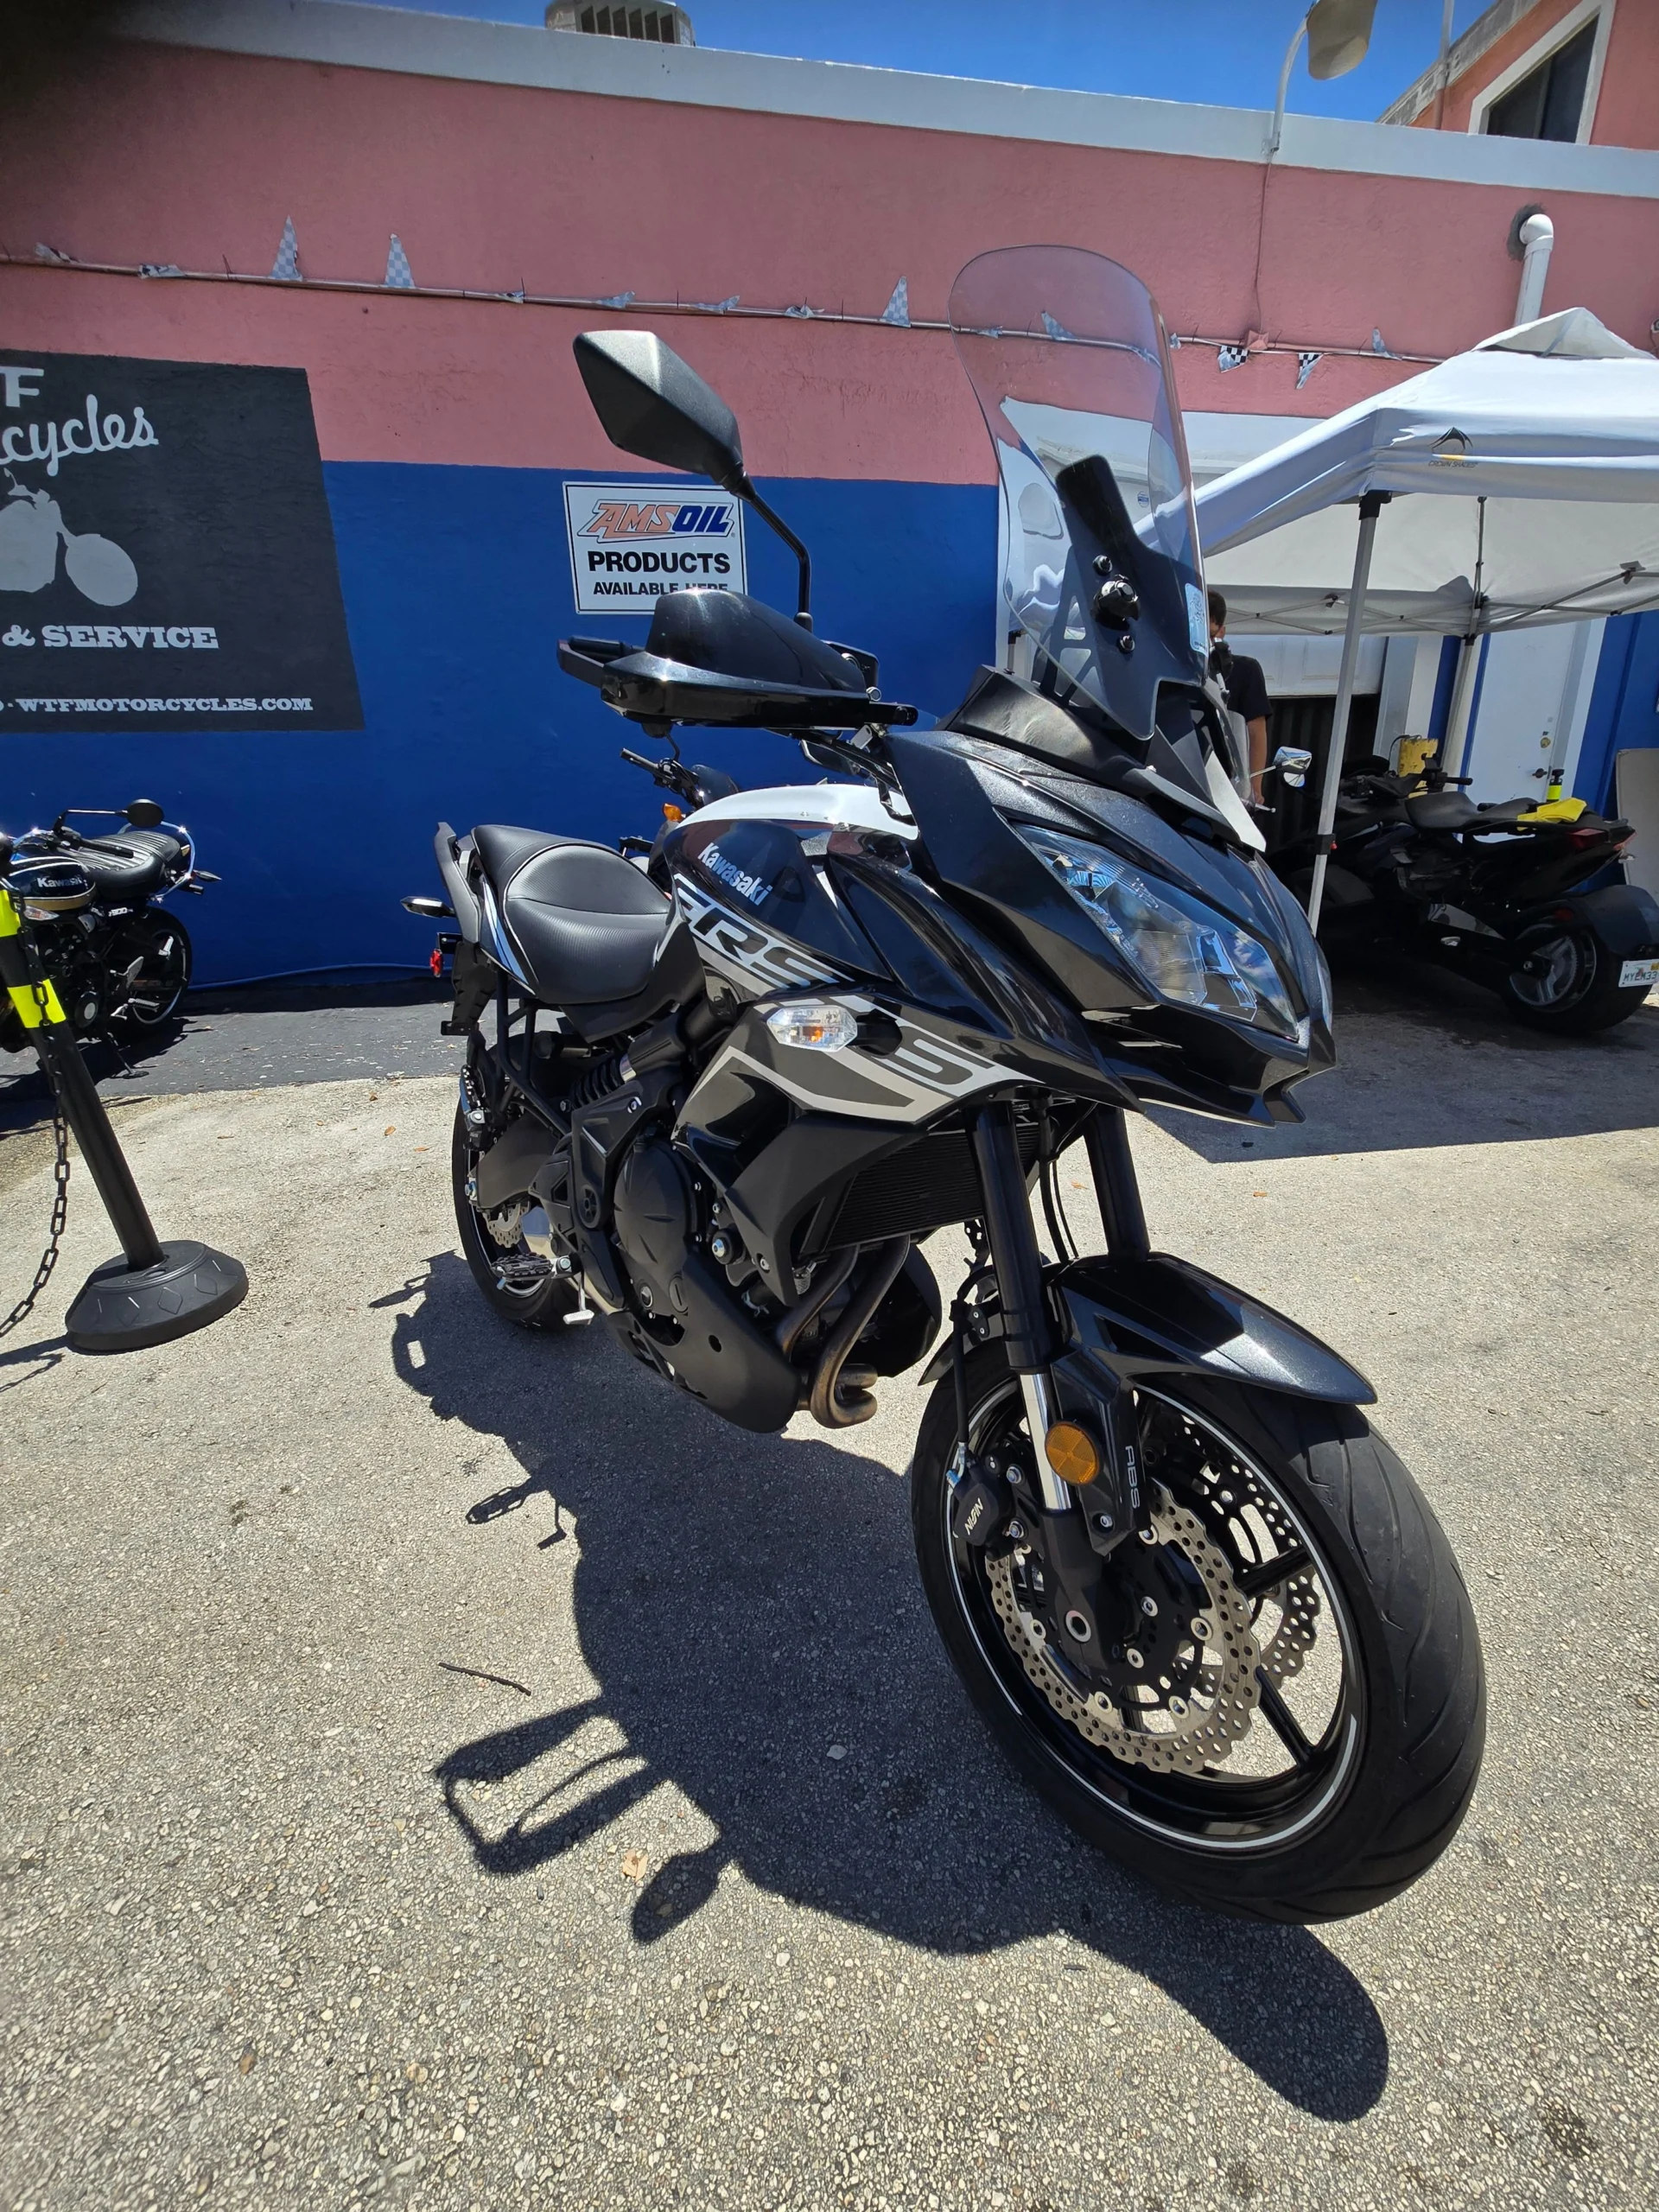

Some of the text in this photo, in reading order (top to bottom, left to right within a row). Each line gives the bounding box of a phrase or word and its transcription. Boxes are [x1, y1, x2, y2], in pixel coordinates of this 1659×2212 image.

[587, 503, 729, 539] AMSOIL
[588, 550, 731, 573] PRODUCTS
[593, 582, 679, 595] AVAILABLE
[2, 625, 219, 648] & SERVICE
[15, 697, 314, 712] WTFMOTORCYCLES.COM
[36, 874, 84, 888] Kawas
[697, 842, 773, 906] Kawasaki
[1125, 1445, 1141, 1509] ABS
